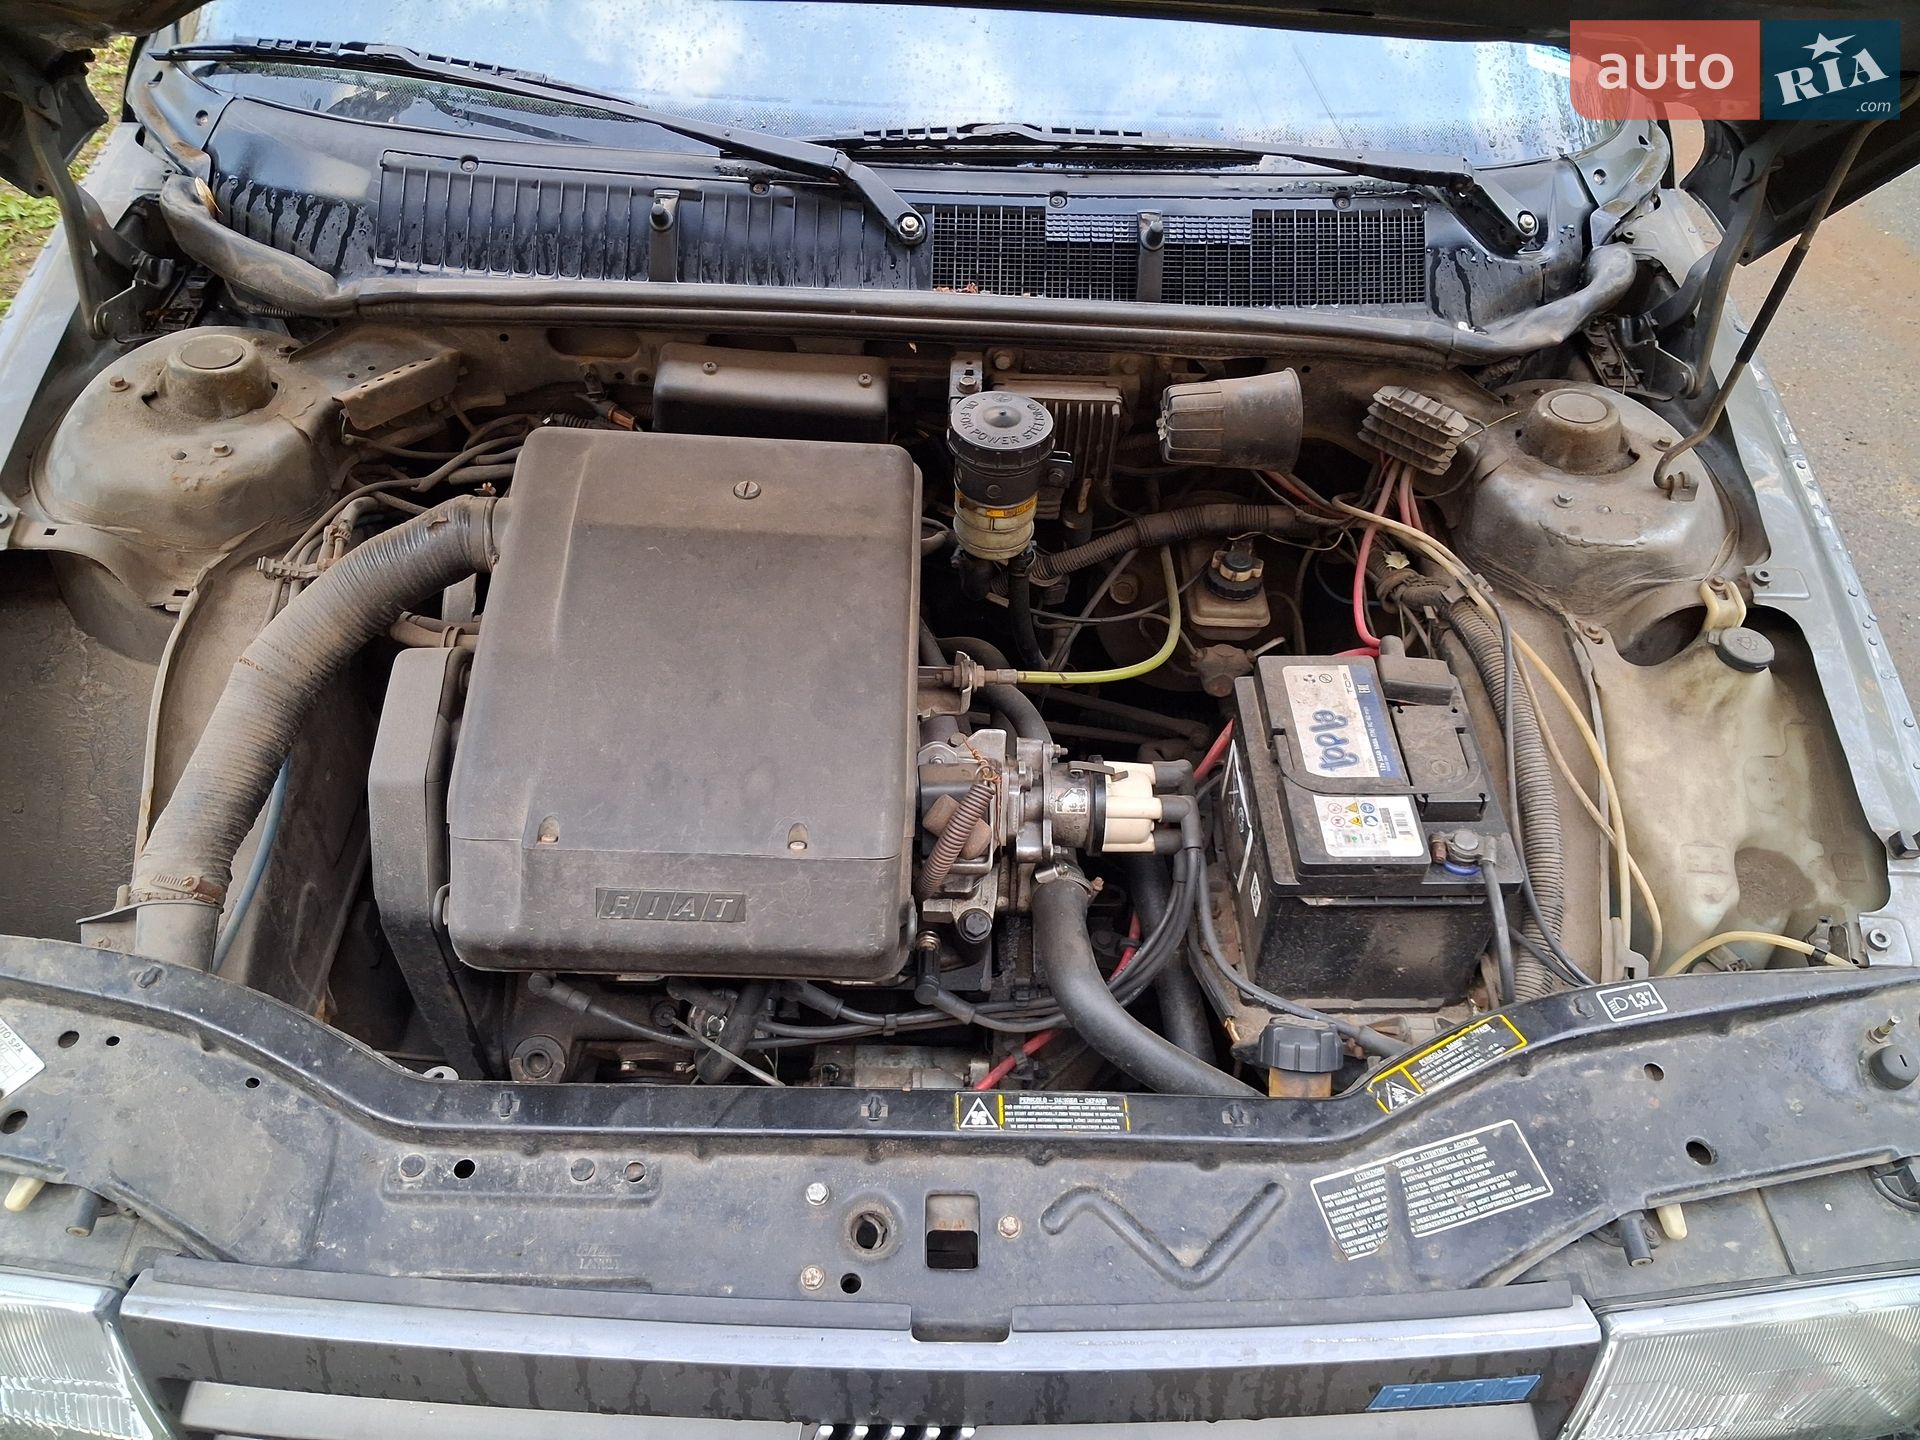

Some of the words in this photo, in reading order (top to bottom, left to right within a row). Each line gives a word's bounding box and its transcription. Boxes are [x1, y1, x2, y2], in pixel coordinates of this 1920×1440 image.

[970, 428, 1020, 445] POWER
[608, 894, 735, 918] FIAT
[1382, 1379, 1530, 1407] FIAT
